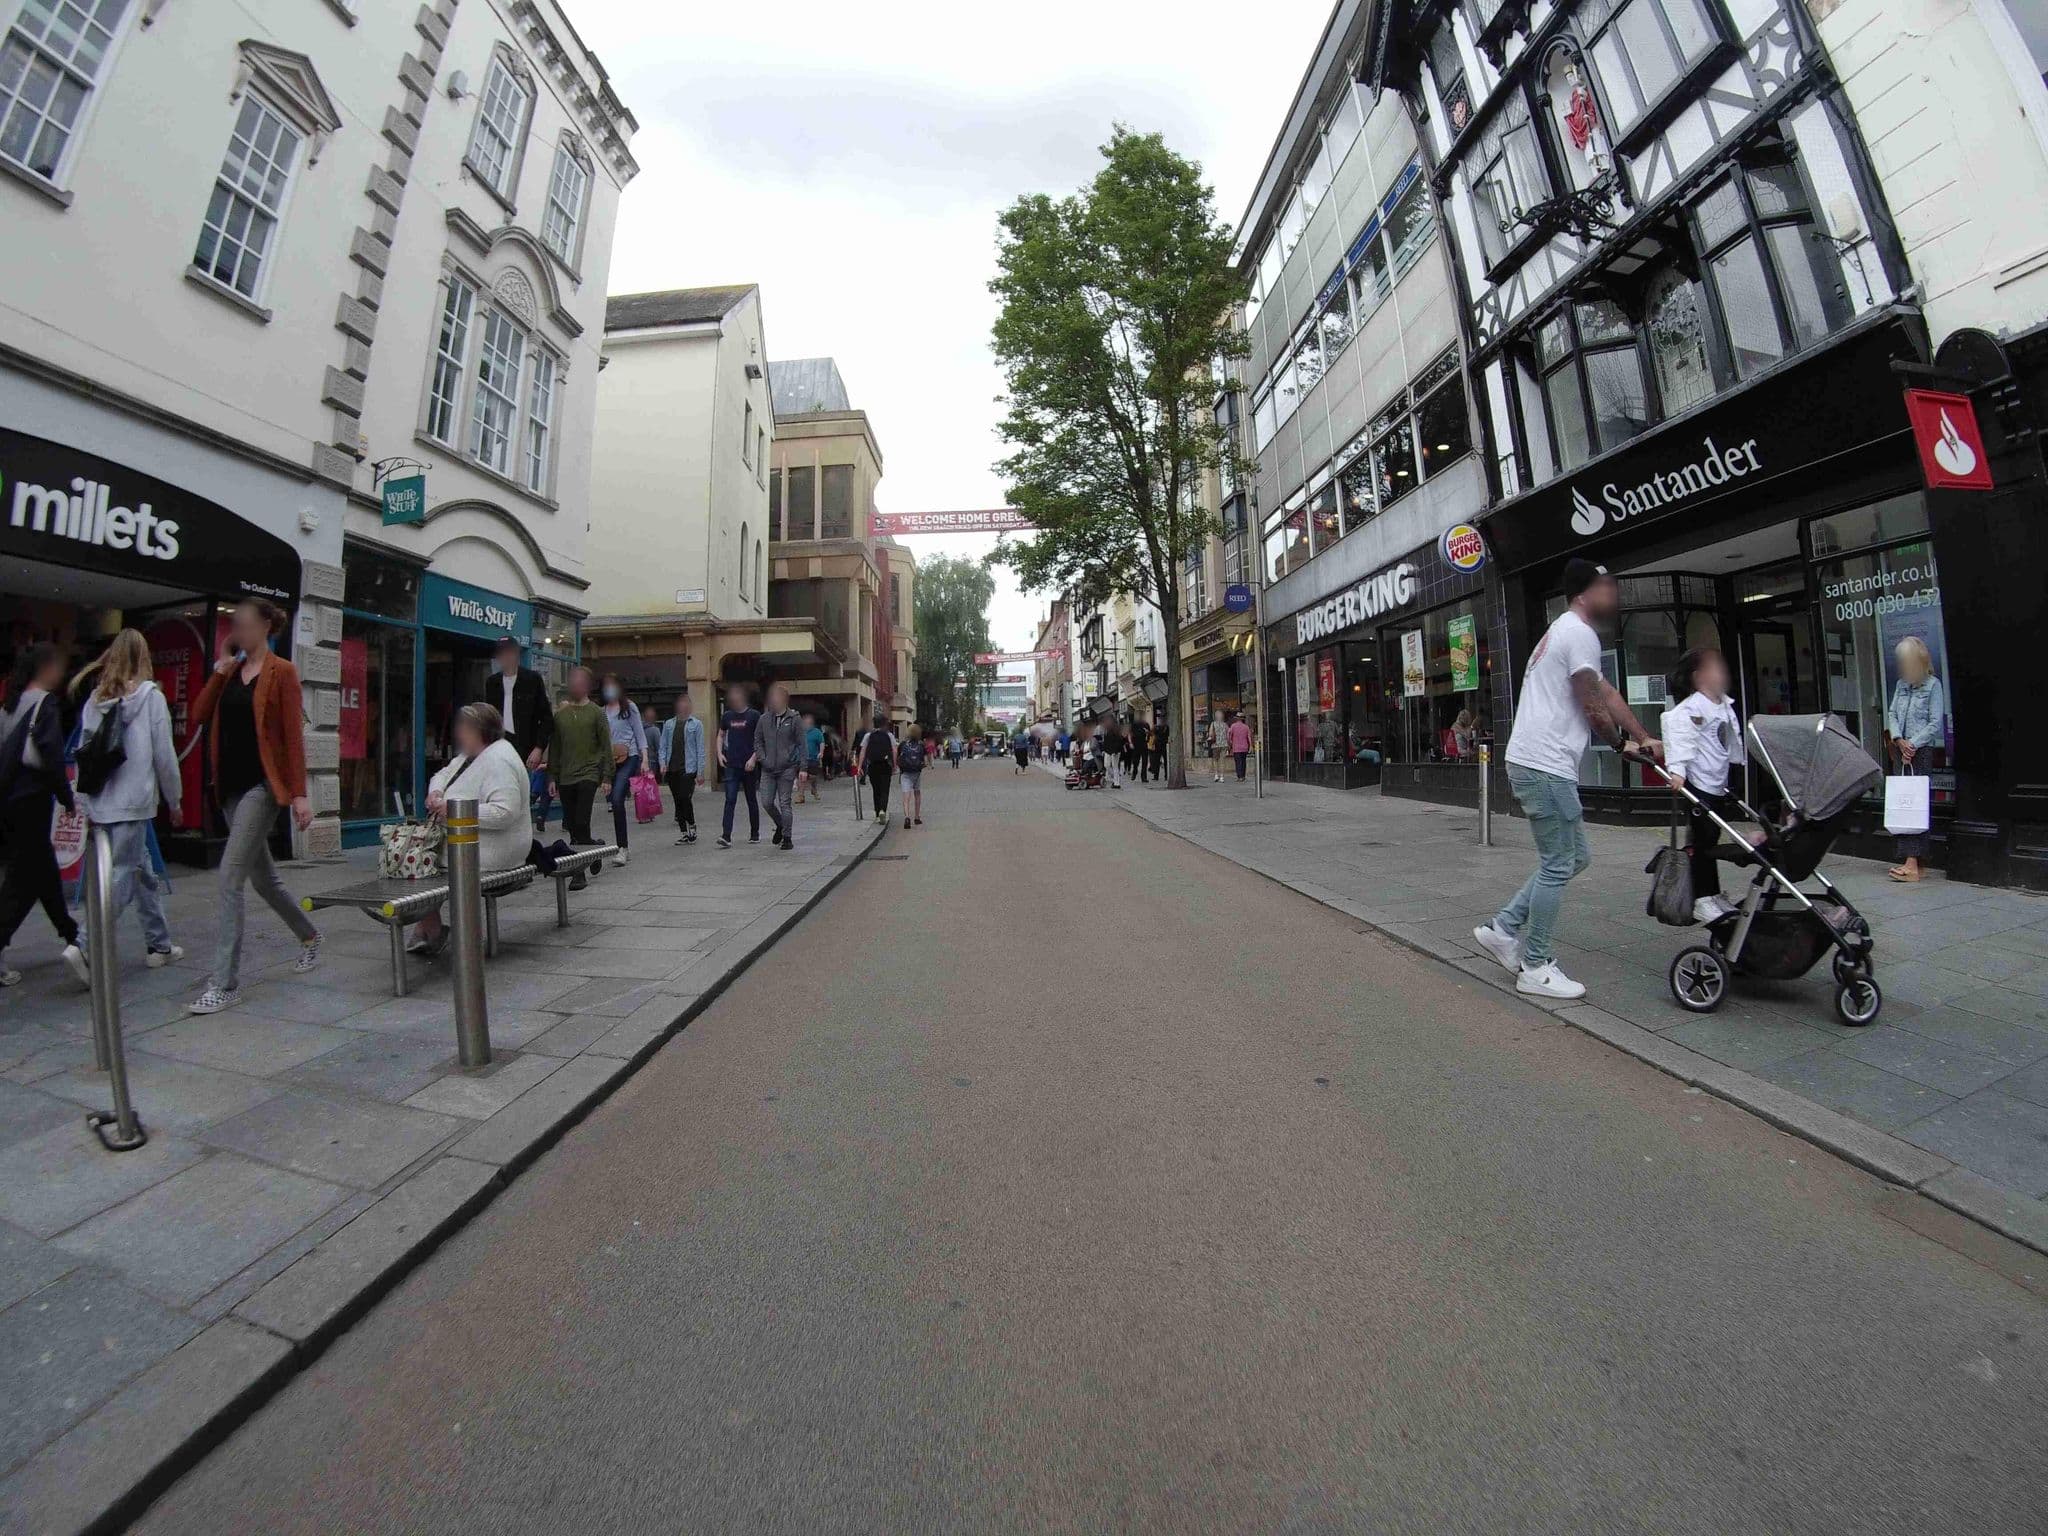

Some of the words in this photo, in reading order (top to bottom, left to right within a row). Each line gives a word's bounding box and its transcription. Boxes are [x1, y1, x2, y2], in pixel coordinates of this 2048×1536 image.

[1602, 436, 1762, 523] Santander
[10, 476, 180, 560] millets
[900, 514, 955, 526] WELCOME
[957, 512, 991, 524] HOME
[1448, 533, 1478, 549] BURGER
[1451, 541, 1482, 561] KING
[240, 581, 251, 590] The
[251, 584, 275, 595] Outdoor
[275, 588, 290, 599] Store
[1229, 594, 1247, 602] REED
[1296, 590, 1357, 645] BURGER
[1358, 563, 1417, 621] KING
[1835, 599, 1873, 621] 0800
[1876, 592, 1906, 615] 030
[341, 688, 360, 709] LE
